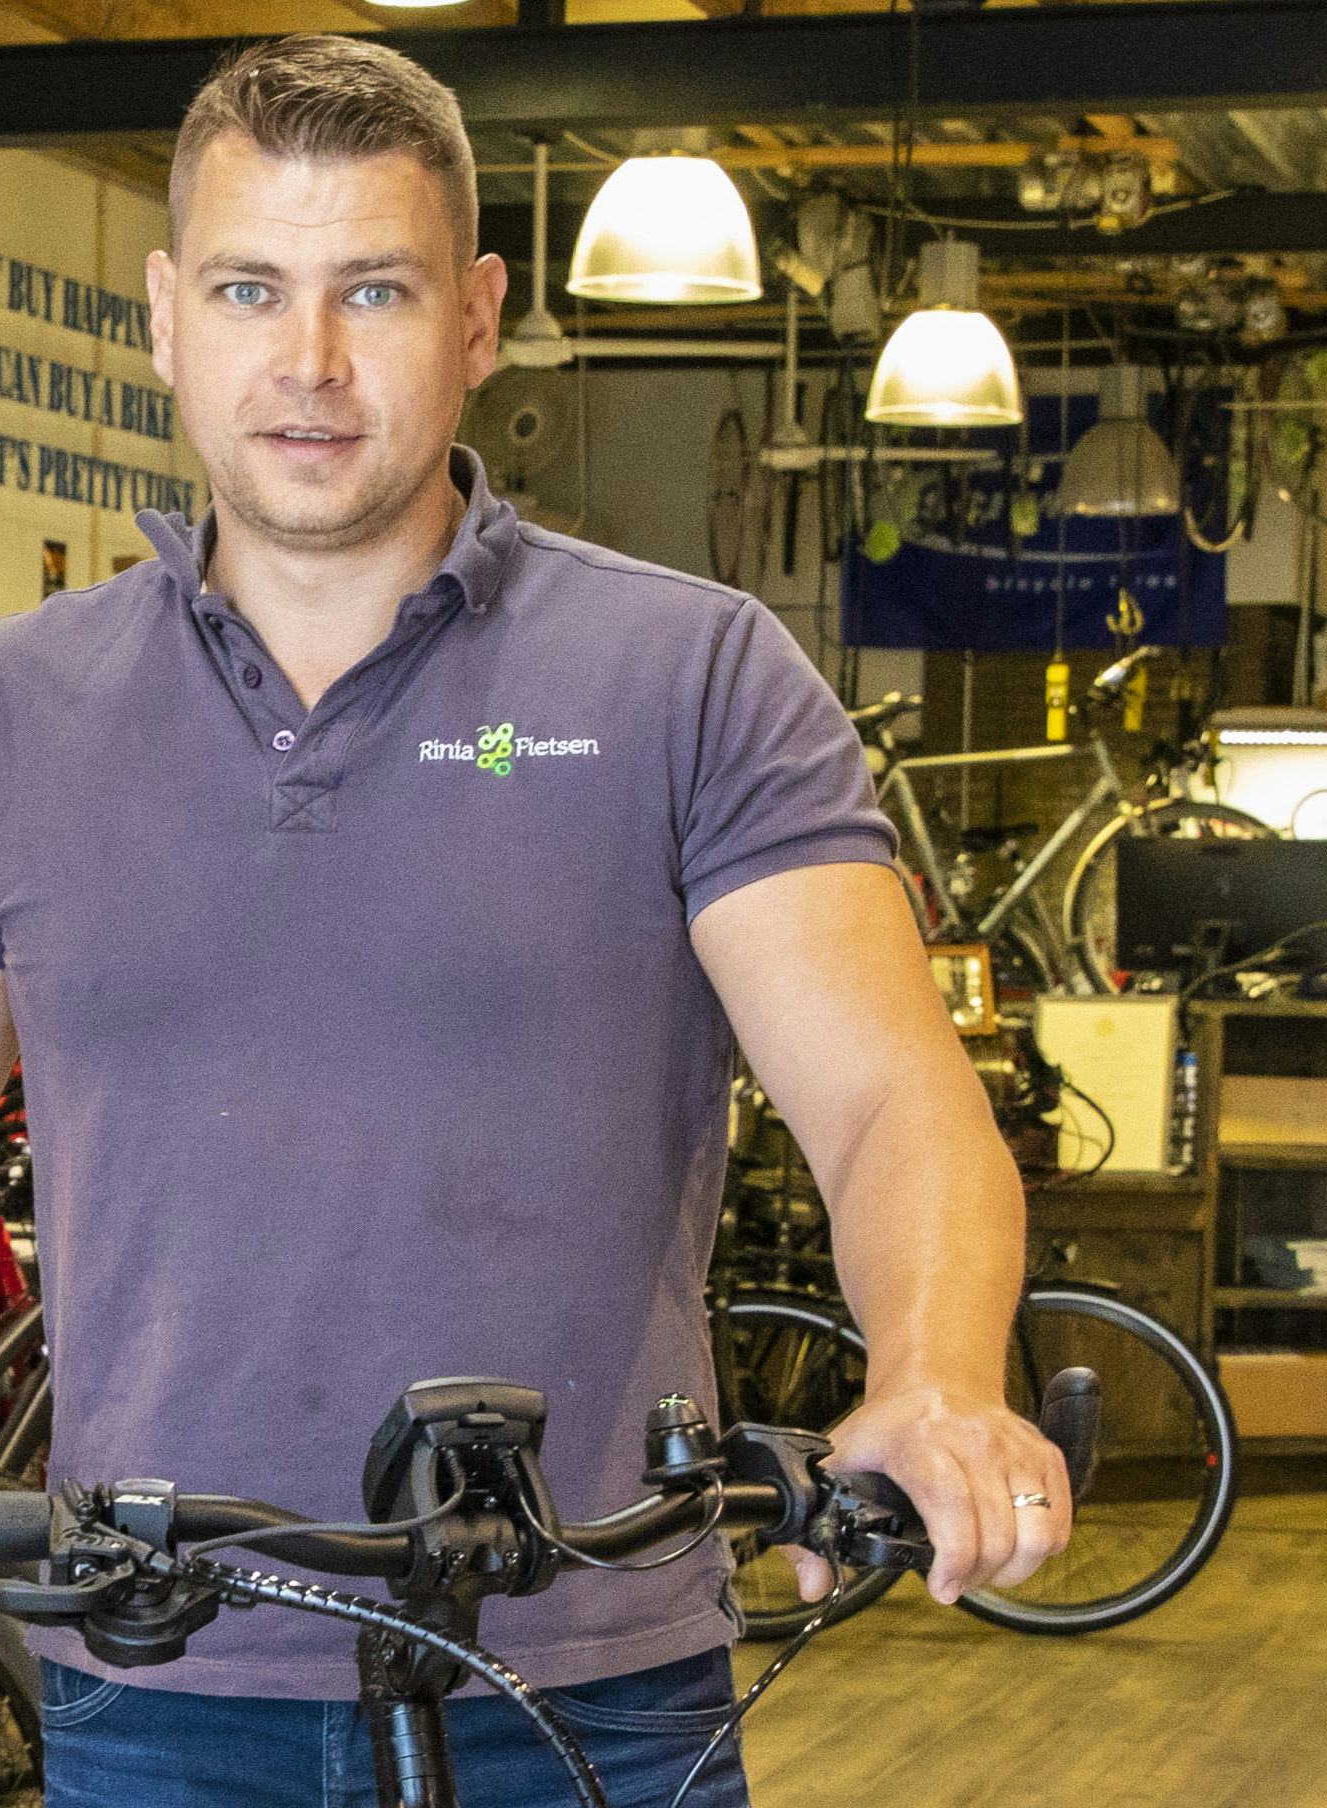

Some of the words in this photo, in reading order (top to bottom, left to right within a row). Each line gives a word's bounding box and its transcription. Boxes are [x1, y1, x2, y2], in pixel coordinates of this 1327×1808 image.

[9, 257, 58, 323] BUY
[48, 361, 101, 423] BUY
[99, 376, 115, 427] A
[121, 382, 174, 442] BIKE
[38, 444, 126, 513] PRETTY
[419, 738, 475, 762] Rinia
[514, 736, 600, 758] Fietsen
